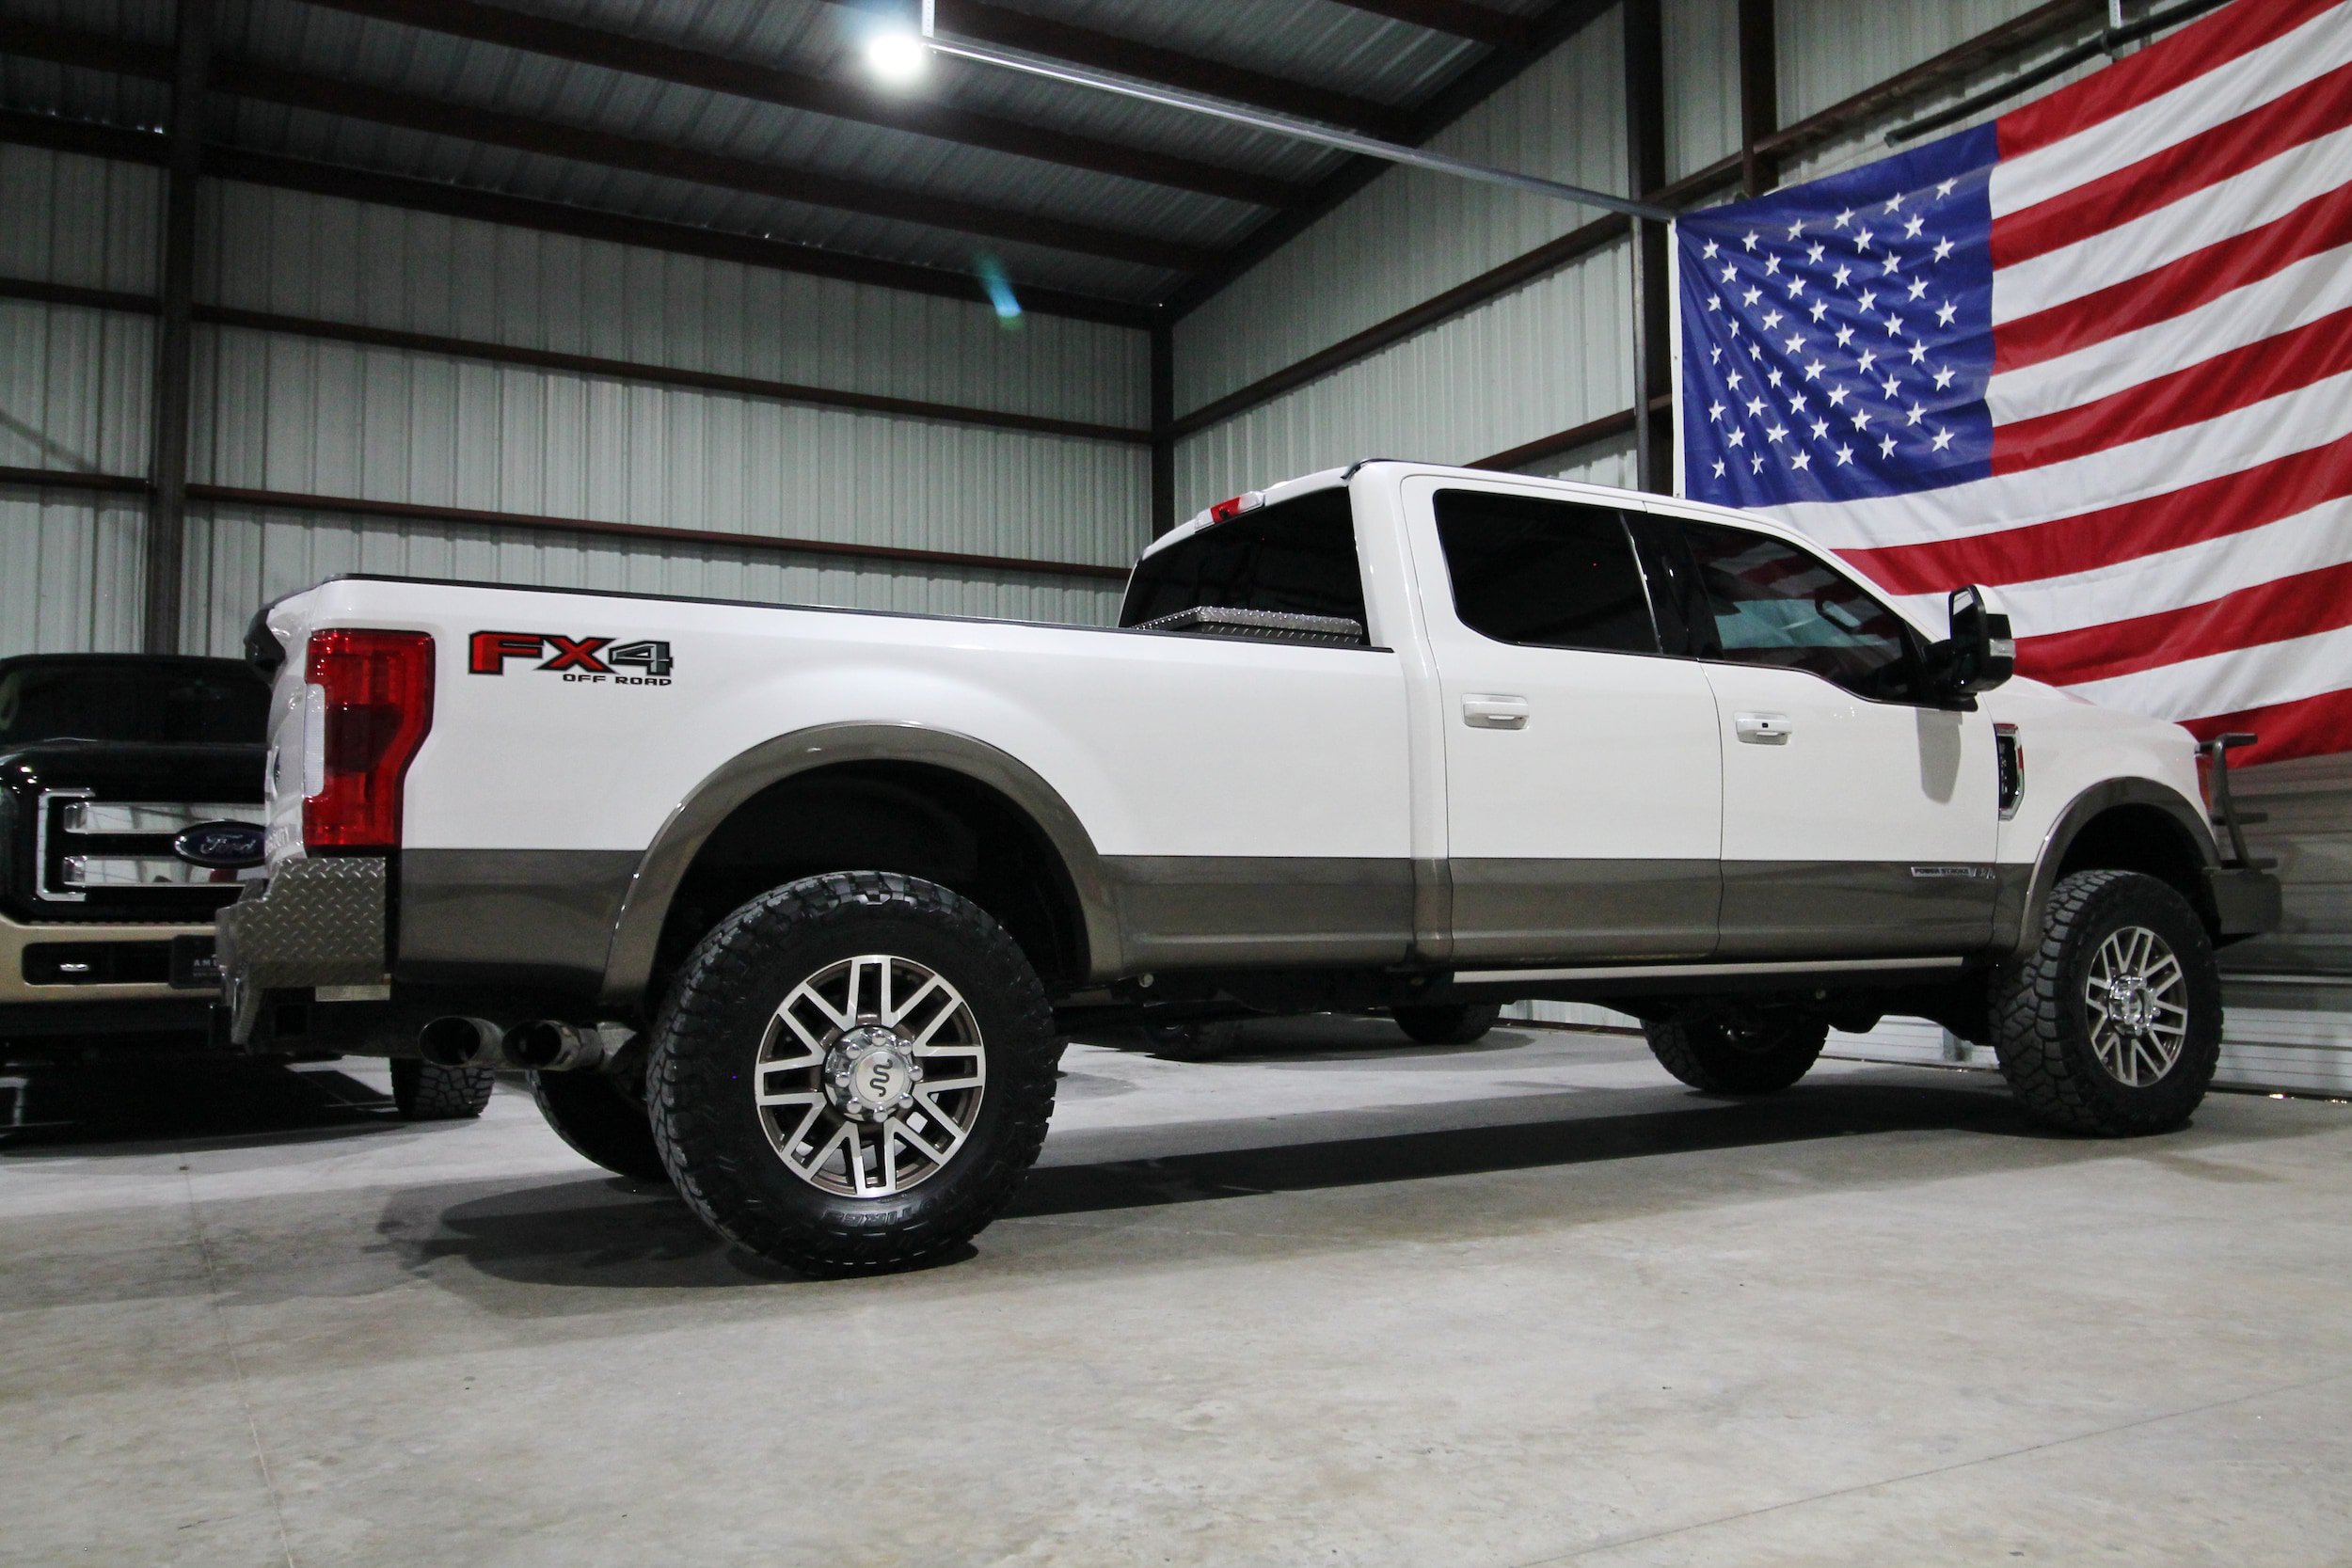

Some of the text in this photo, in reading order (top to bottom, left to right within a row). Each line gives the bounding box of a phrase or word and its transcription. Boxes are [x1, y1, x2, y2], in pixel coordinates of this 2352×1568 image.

[469, 630, 673, 676] FX4
[563, 673, 673, 686] OFF ROAD
[199, 834, 256, 855] Ford
